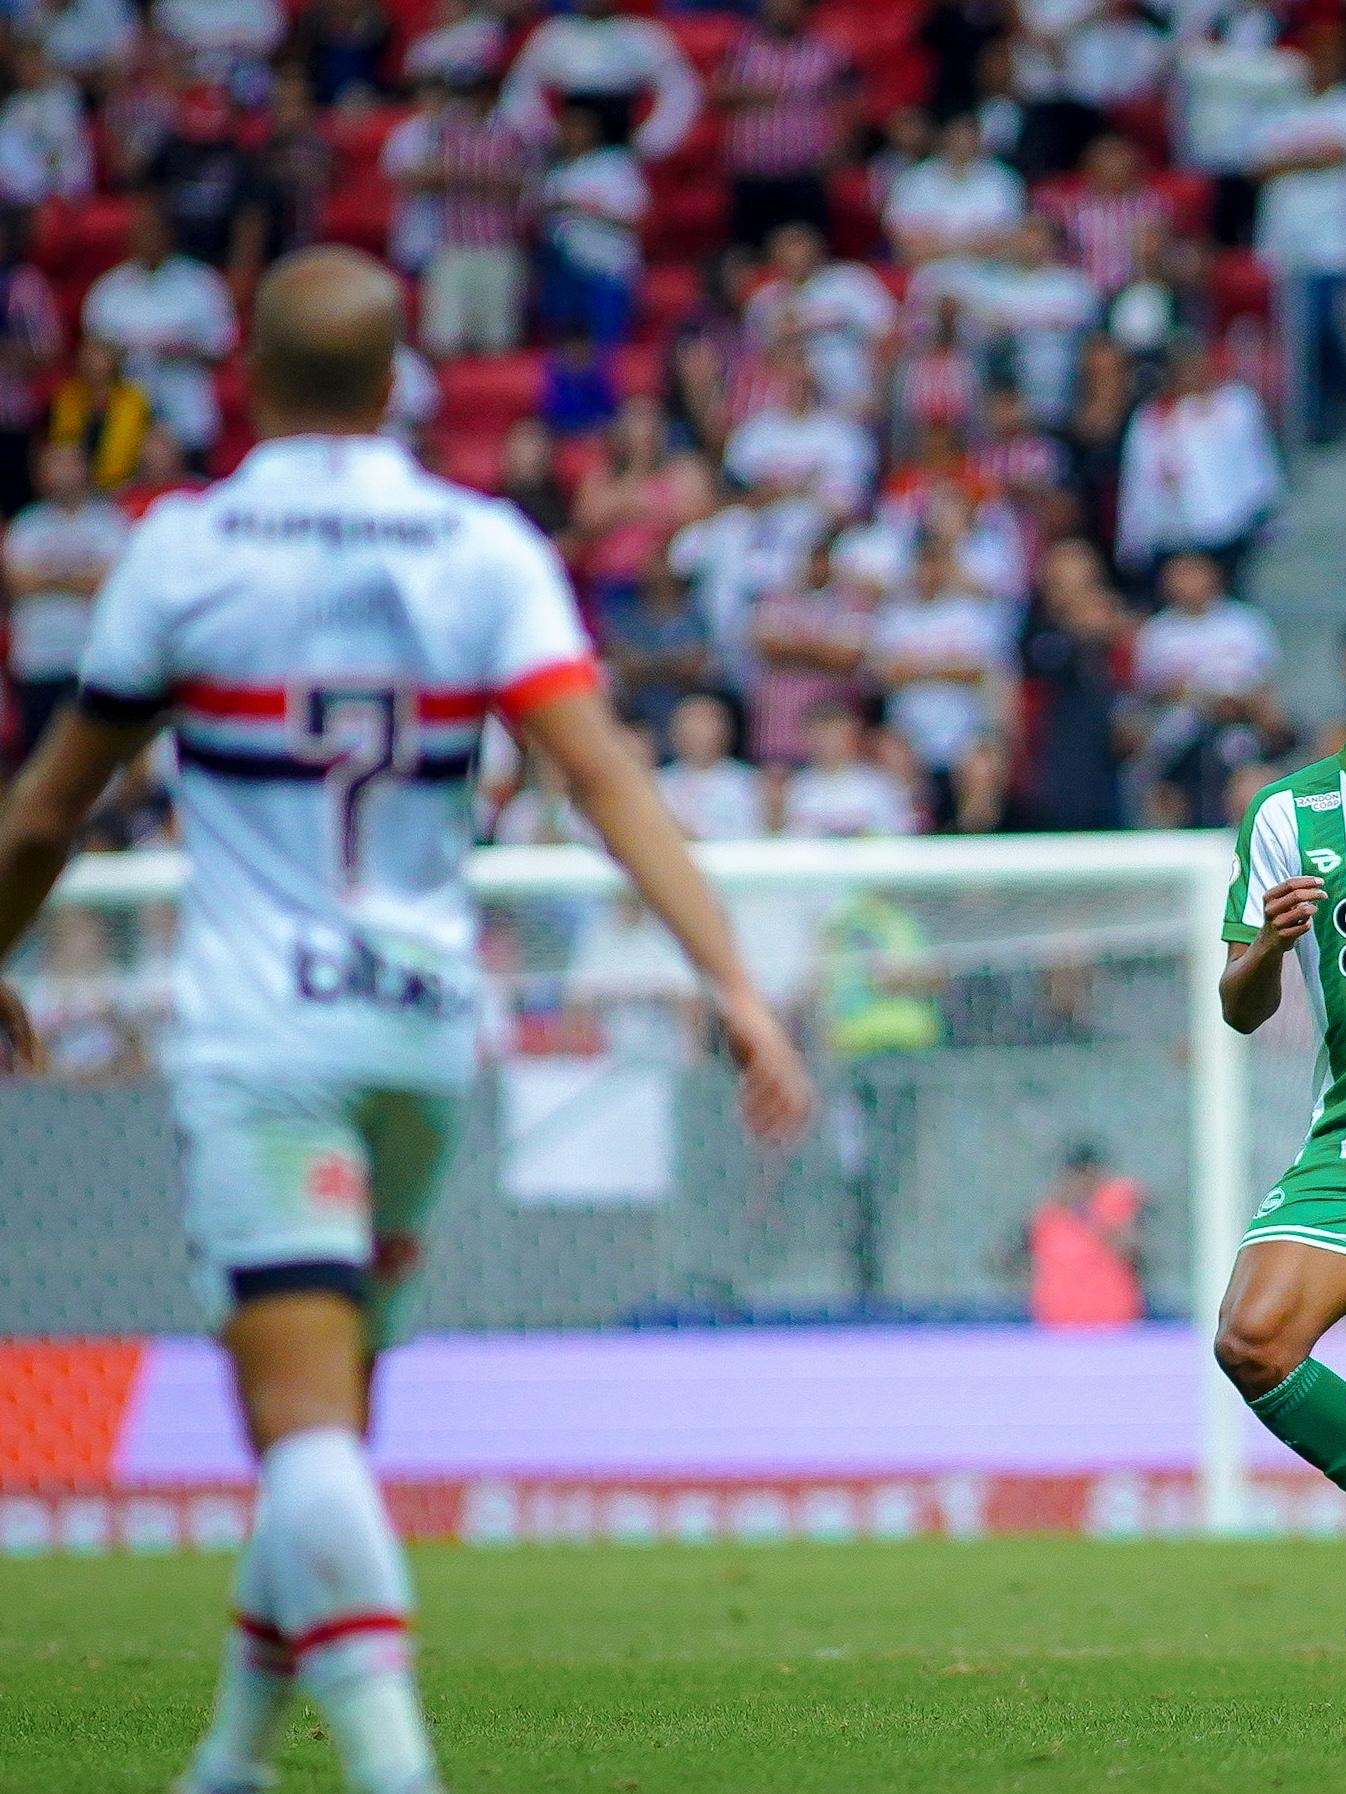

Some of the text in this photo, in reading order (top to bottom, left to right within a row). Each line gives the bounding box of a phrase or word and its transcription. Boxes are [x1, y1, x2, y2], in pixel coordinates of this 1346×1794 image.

[295, 676, 410, 895] 7
[1298, 793, 1340, 806] RANDON
[1312, 799, 1340, 810] CORP
